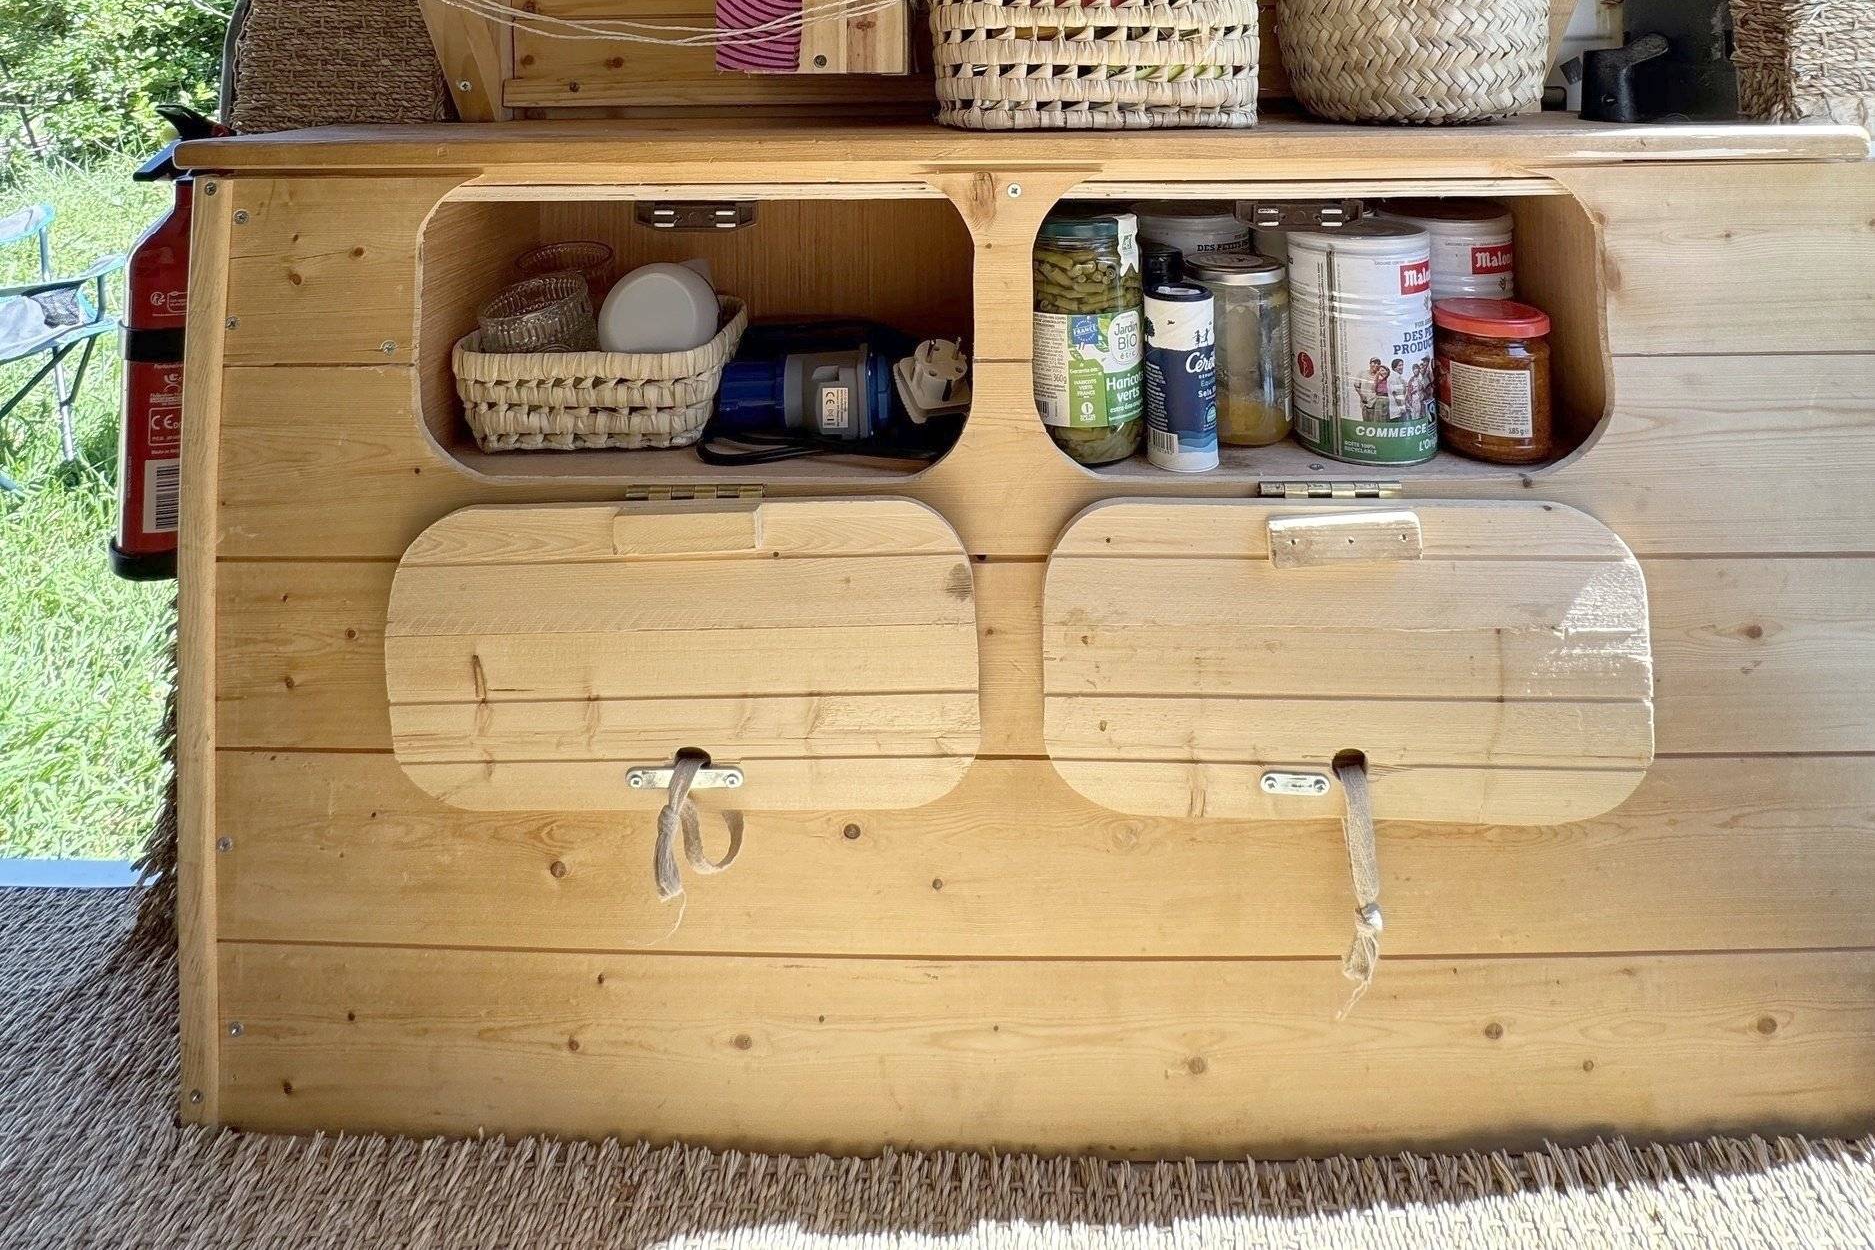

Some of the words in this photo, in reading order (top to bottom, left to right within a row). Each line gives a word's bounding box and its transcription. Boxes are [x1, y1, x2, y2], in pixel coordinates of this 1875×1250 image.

[1197, 244, 1216, 252] DES
[1114, 320, 1138, 336] Jardin
[1403, 329, 1424, 343] DES
[1116, 386, 1140, 403] verts
[1355, 422, 1427, 438] COMMERCE
